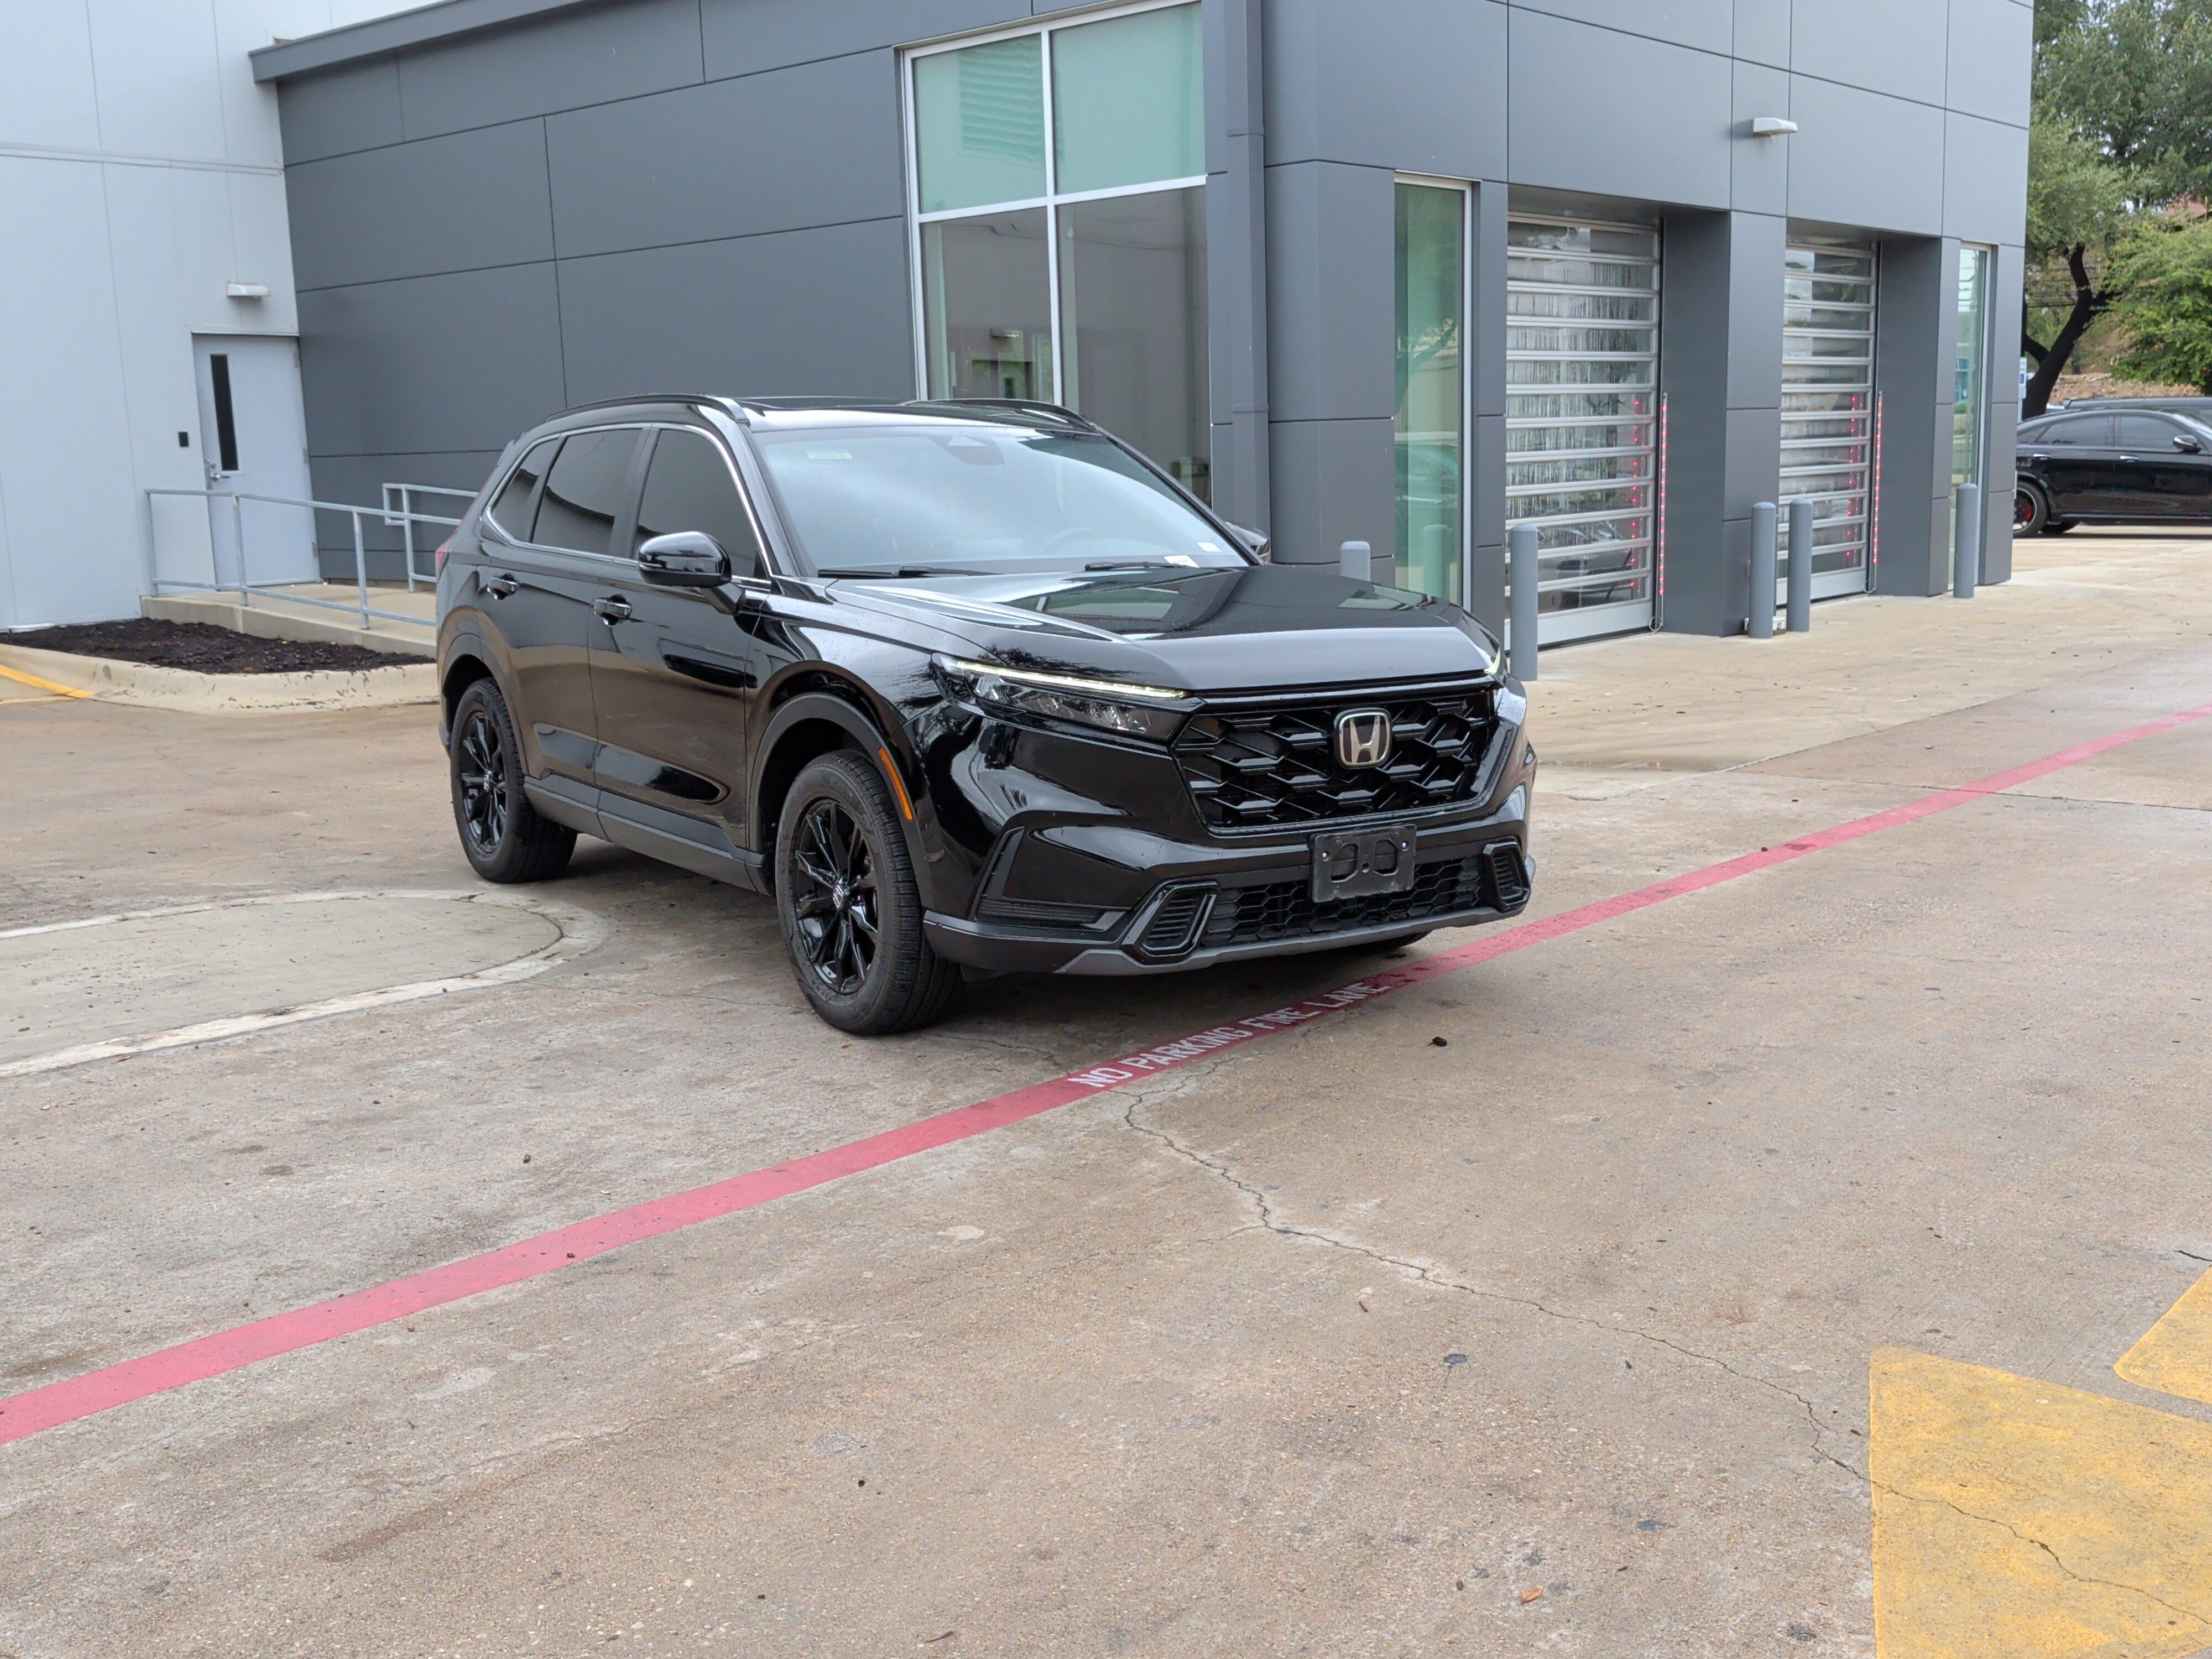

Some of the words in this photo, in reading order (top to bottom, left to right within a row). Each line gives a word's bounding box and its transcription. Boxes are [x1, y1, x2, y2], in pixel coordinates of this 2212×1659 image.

[1066, 1067, 1134, 1088] NO
[1118, 1026, 1254, 1071] PARKING
[1238, 1007, 1322, 1030] FIRE
[1302, 982, 1391, 1008] LANE
